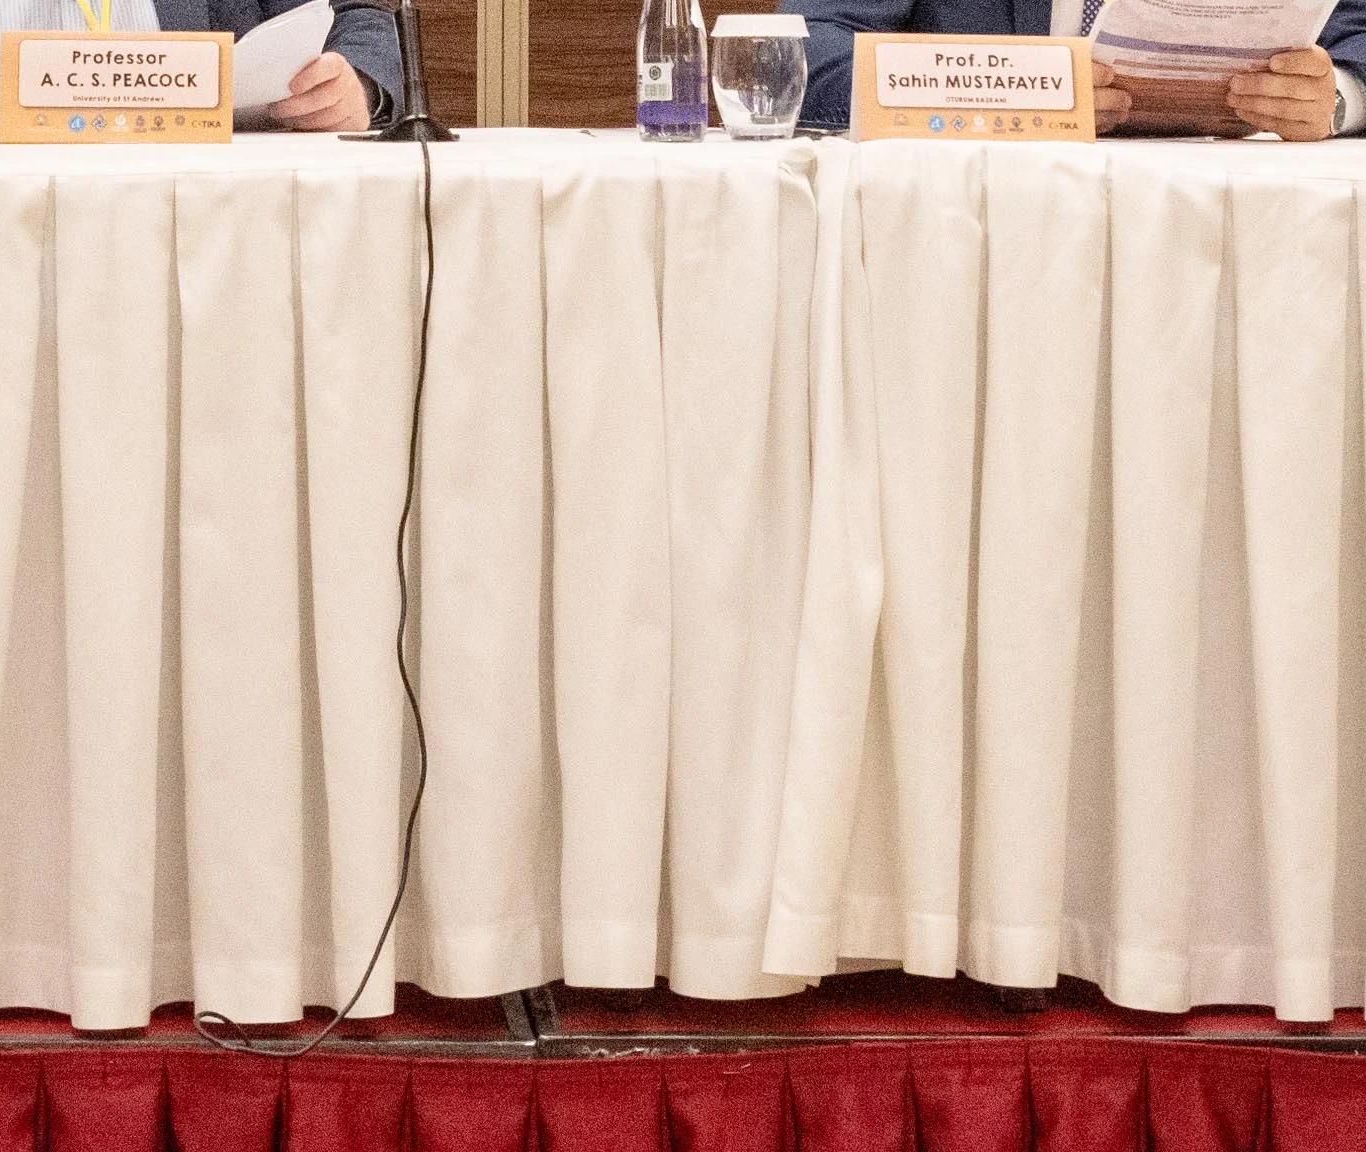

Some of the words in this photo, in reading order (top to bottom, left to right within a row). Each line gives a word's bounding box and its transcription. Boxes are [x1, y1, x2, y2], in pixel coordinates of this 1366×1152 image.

[72, 51, 167, 65] Professor
[935, 53, 981, 68] Prof.
[988, 54, 1014, 68] Dr.
[41, 73, 60, 87] A.
[67, 73, 84, 87] C.
[91, 73, 106, 87] S.
[113, 73, 197, 87] PEACOCK
[888, 73, 939, 91] Şahin
[946, 75, 1063, 90] MUSTAFAYEV
